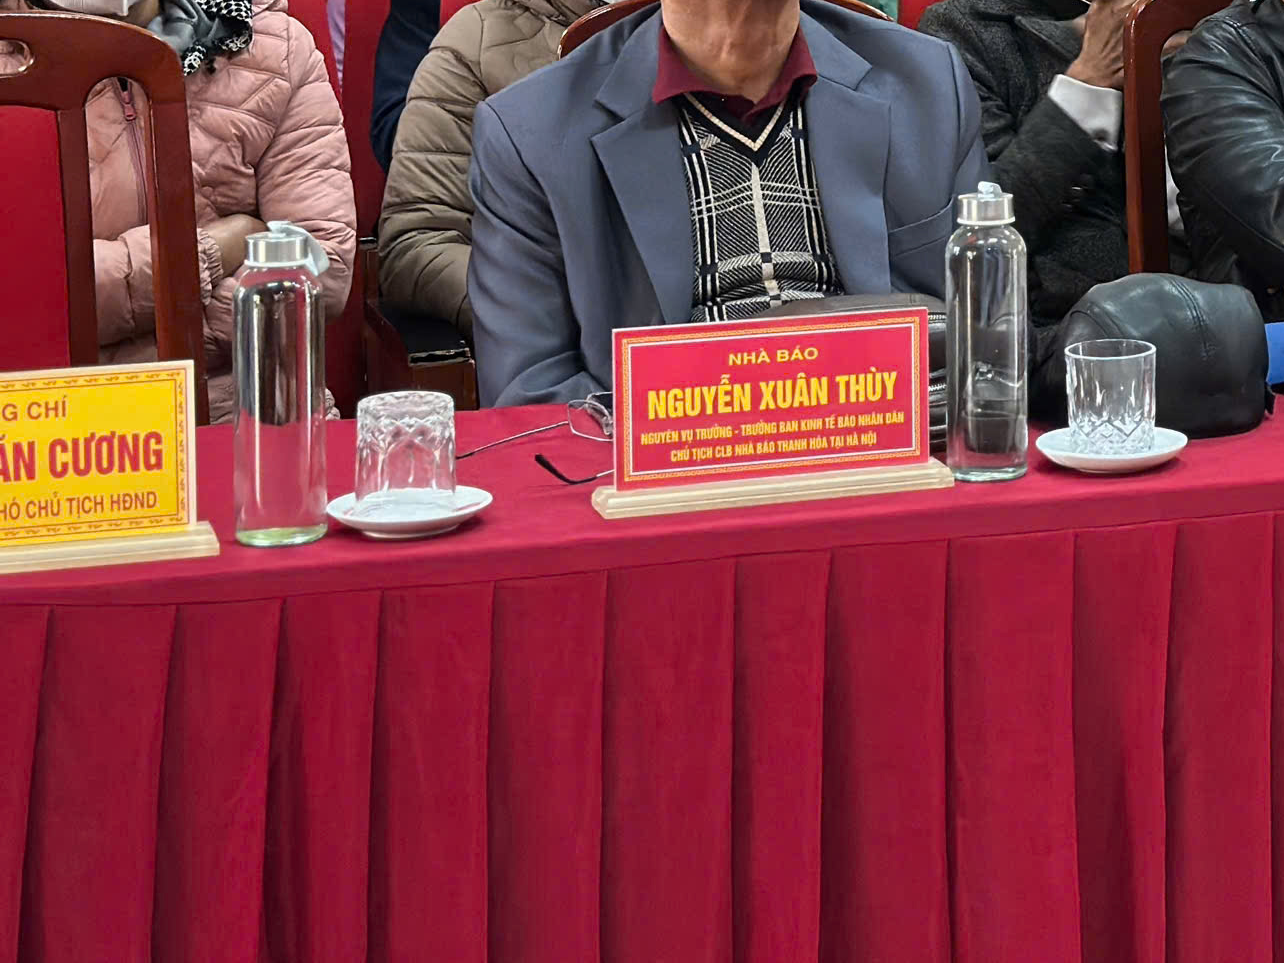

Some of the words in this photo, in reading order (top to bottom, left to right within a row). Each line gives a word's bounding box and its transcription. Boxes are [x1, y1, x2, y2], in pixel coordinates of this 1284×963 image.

[728, 347, 771, 366] NHÀ
[776, 345, 819, 363] BÁO
[27, 395, 67, 420] CHÍ
[647, 373, 752, 420] NGUYỄN
[759, 371, 829, 411] XUÂN
[835, 365, 898, 405] THÙY
[681, 429, 694, 444] VỤ
[779, 420, 799, 434] BAN
[800, 418, 823, 431] KINH
[825, 414, 836, 429] TẾ
[837, 414, 857, 428] BÁO
[858, 411, 884, 426] NHÂN
[886, 410, 905, 424] DÂN
[48, 431, 163, 479] CƯƠNG
[670, 444, 690, 462] CHỦ
[692, 445, 713, 461] TỊCH
[715, 444, 732, 458] CLB
[735, 440, 754, 456] NHÀ
[756, 440, 776, 454] BÁO
[777, 438, 808, 453] THANH
[809, 434, 829, 449] HÓA
[829, 435, 845, 449] TẠI
[846, 431, 859, 446] HÀ
[861, 430, 878, 447] NỘI
[25, 491, 61, 519] CHỦ
[66, 495, 104, 518] TỊCH
[110, 491, 157, 511] HĐND
